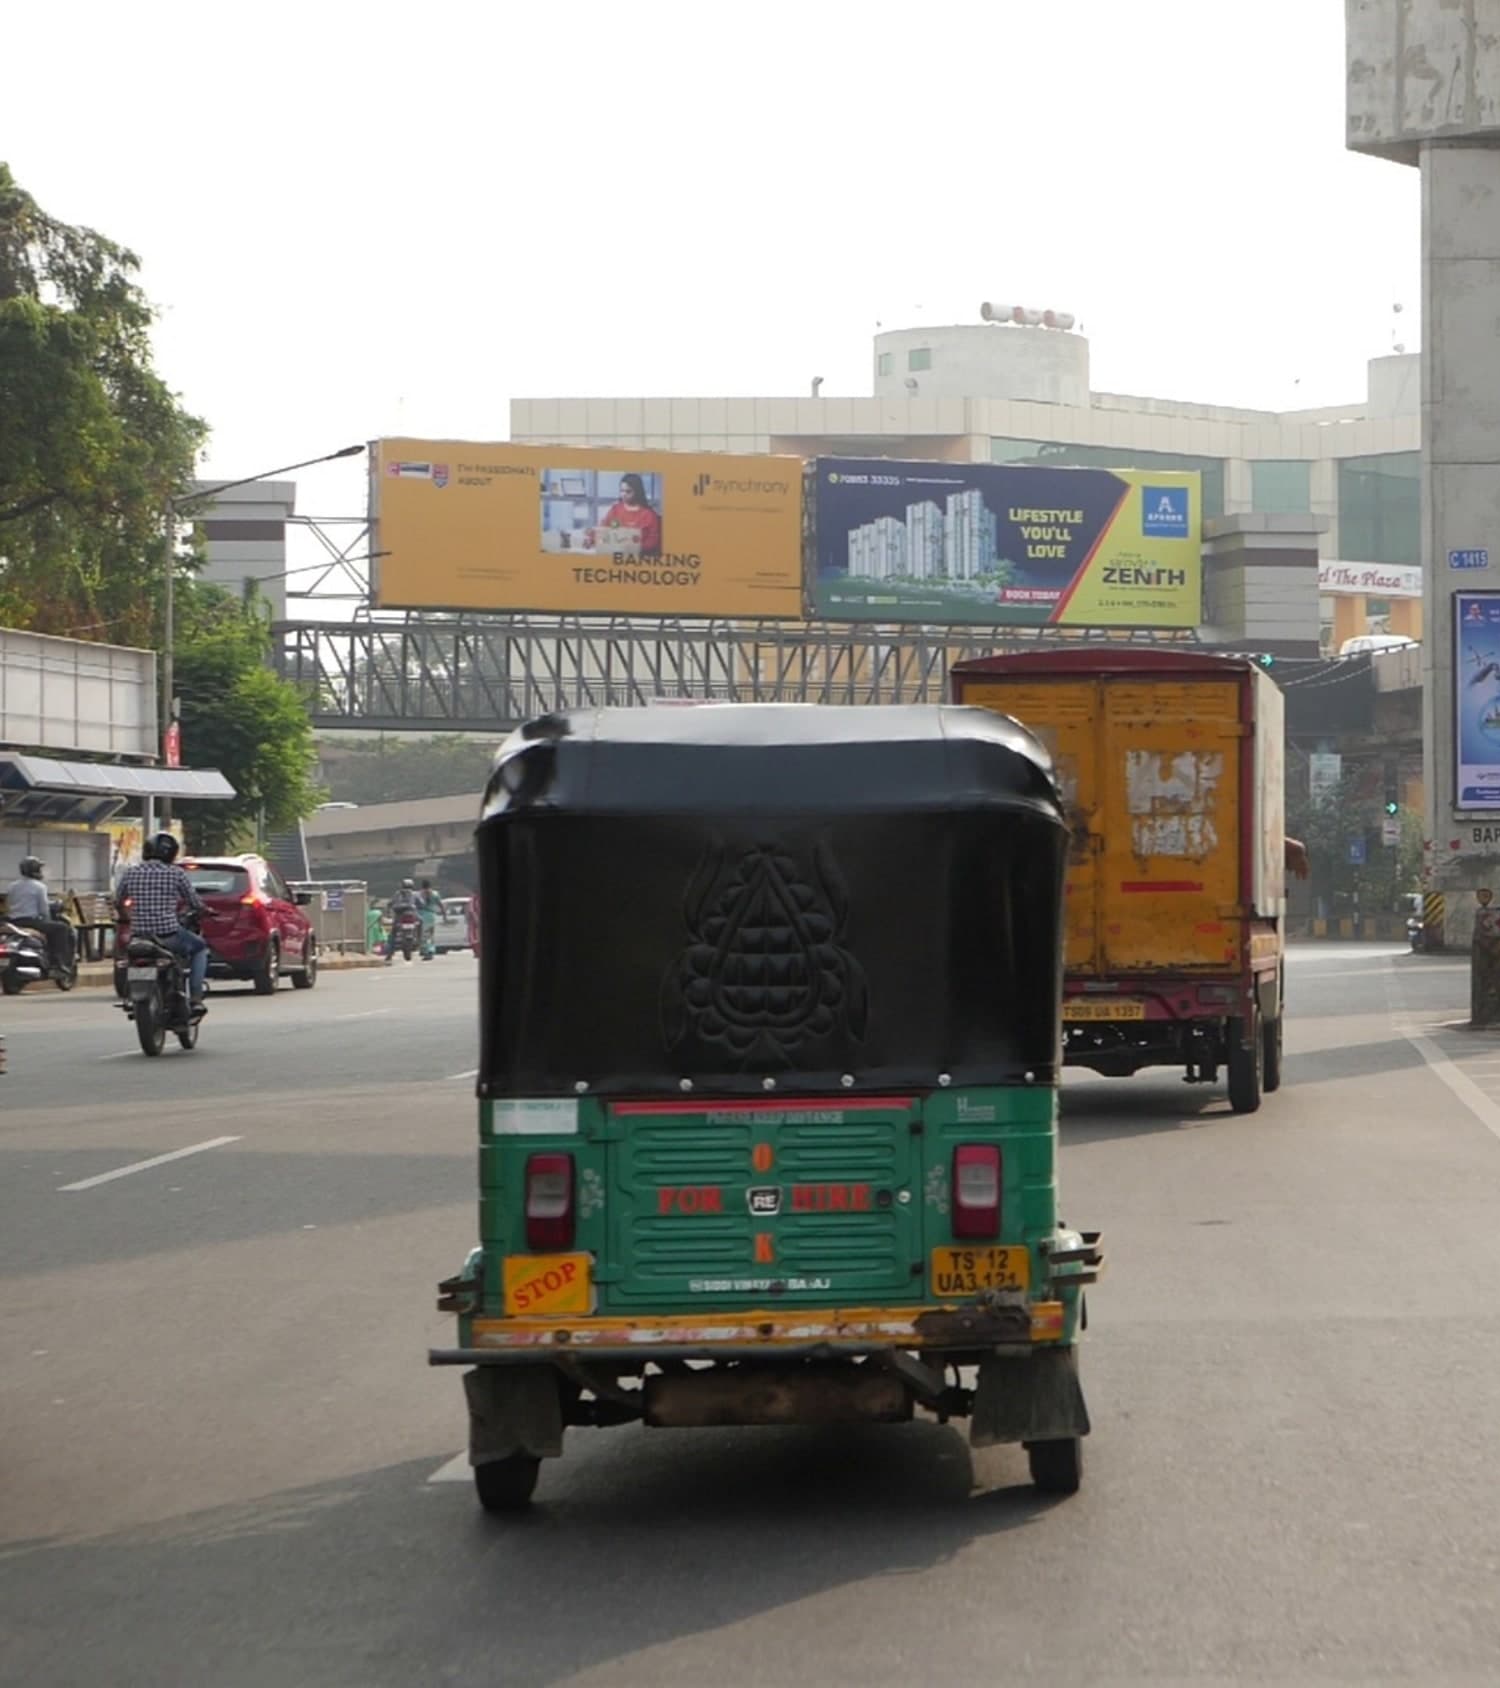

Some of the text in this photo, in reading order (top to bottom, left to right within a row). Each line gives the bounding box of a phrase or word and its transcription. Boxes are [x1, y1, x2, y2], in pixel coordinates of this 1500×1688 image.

[1008, 508, 1083, 523] LIFESTYLE
[1020, 526, 1072, 541] YOU'LL
[613, 551, 701, 569] BANKING
[1027, 545, 1066, 558] LOVE
[1450, 552, 1459, 567] C
[572, 567, 701, 586] TECHNOLOGY
[1330, 567, 1358, 586] The
[1361, 568, 1401, 588] Plaza
[656, 1185, 723, 1215] FOR
[791, 1183, 871, 1212] HIRE
[753, 1232, 774, 1263] K
[949, 1250, 1009, 1270] TS 12
[513, 1261, 577, 1310] STOP
